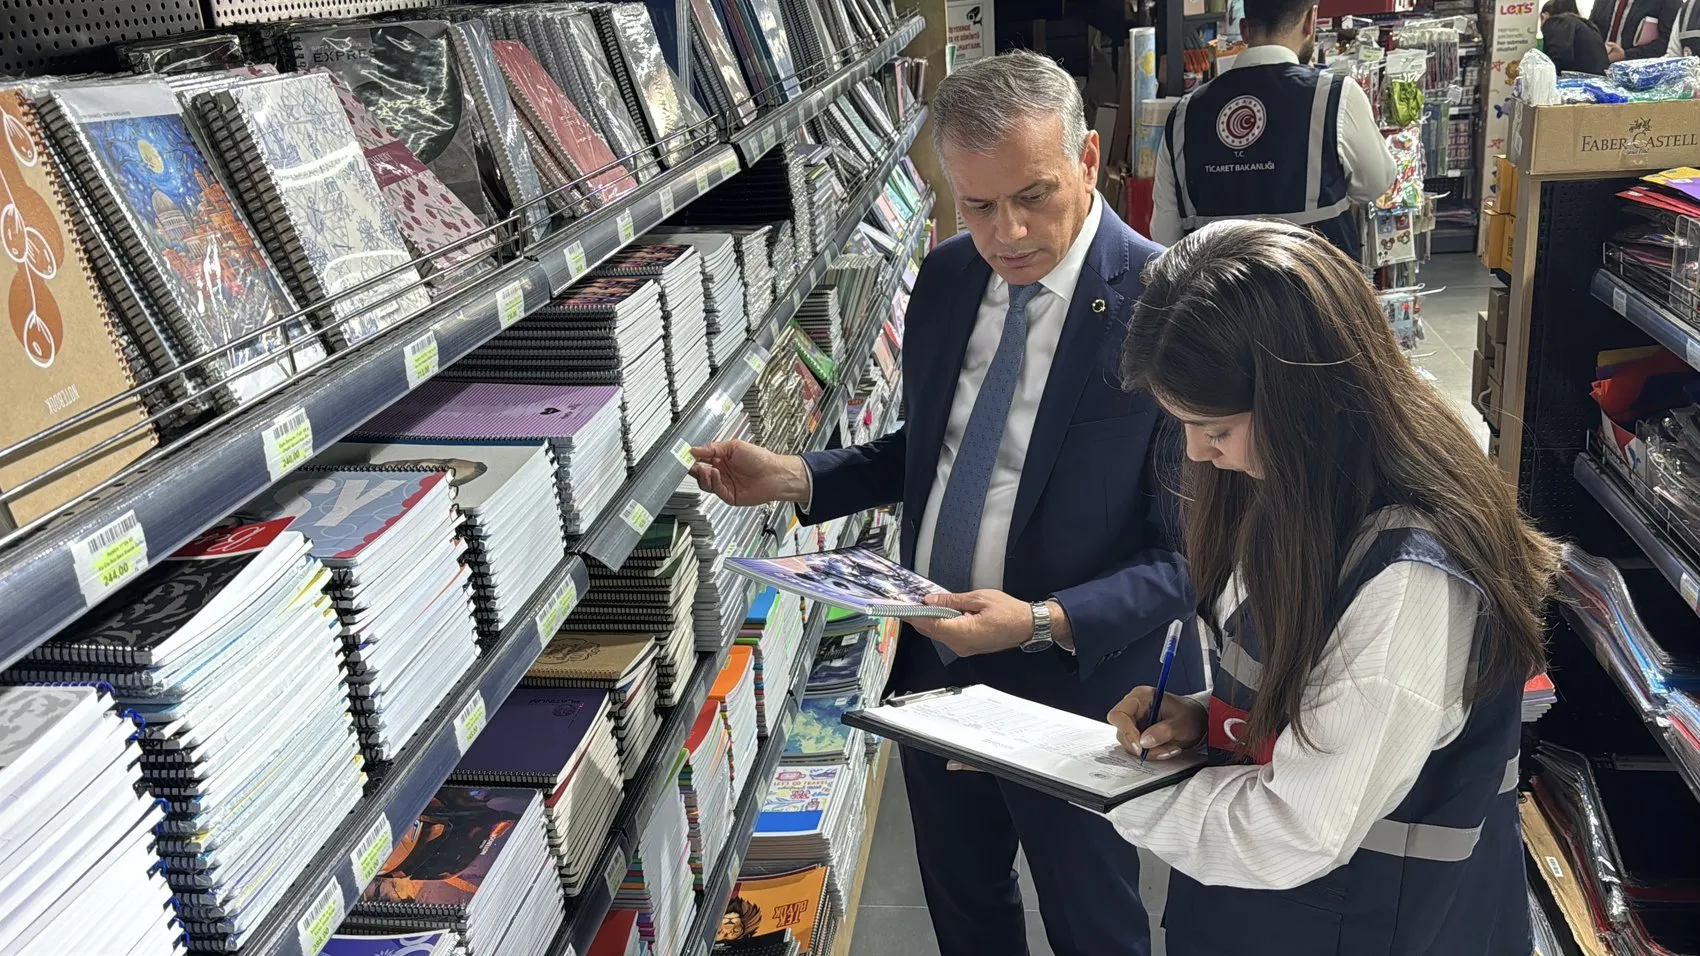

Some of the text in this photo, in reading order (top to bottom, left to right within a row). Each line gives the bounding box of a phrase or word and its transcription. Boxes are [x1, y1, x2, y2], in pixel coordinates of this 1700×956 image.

[1204, 160, 1275, 173] TİCARET BAKANLIĞI
[45, 383, 81, 416] NOTEBOOK
[102, 562, 130, 587] 244,00
